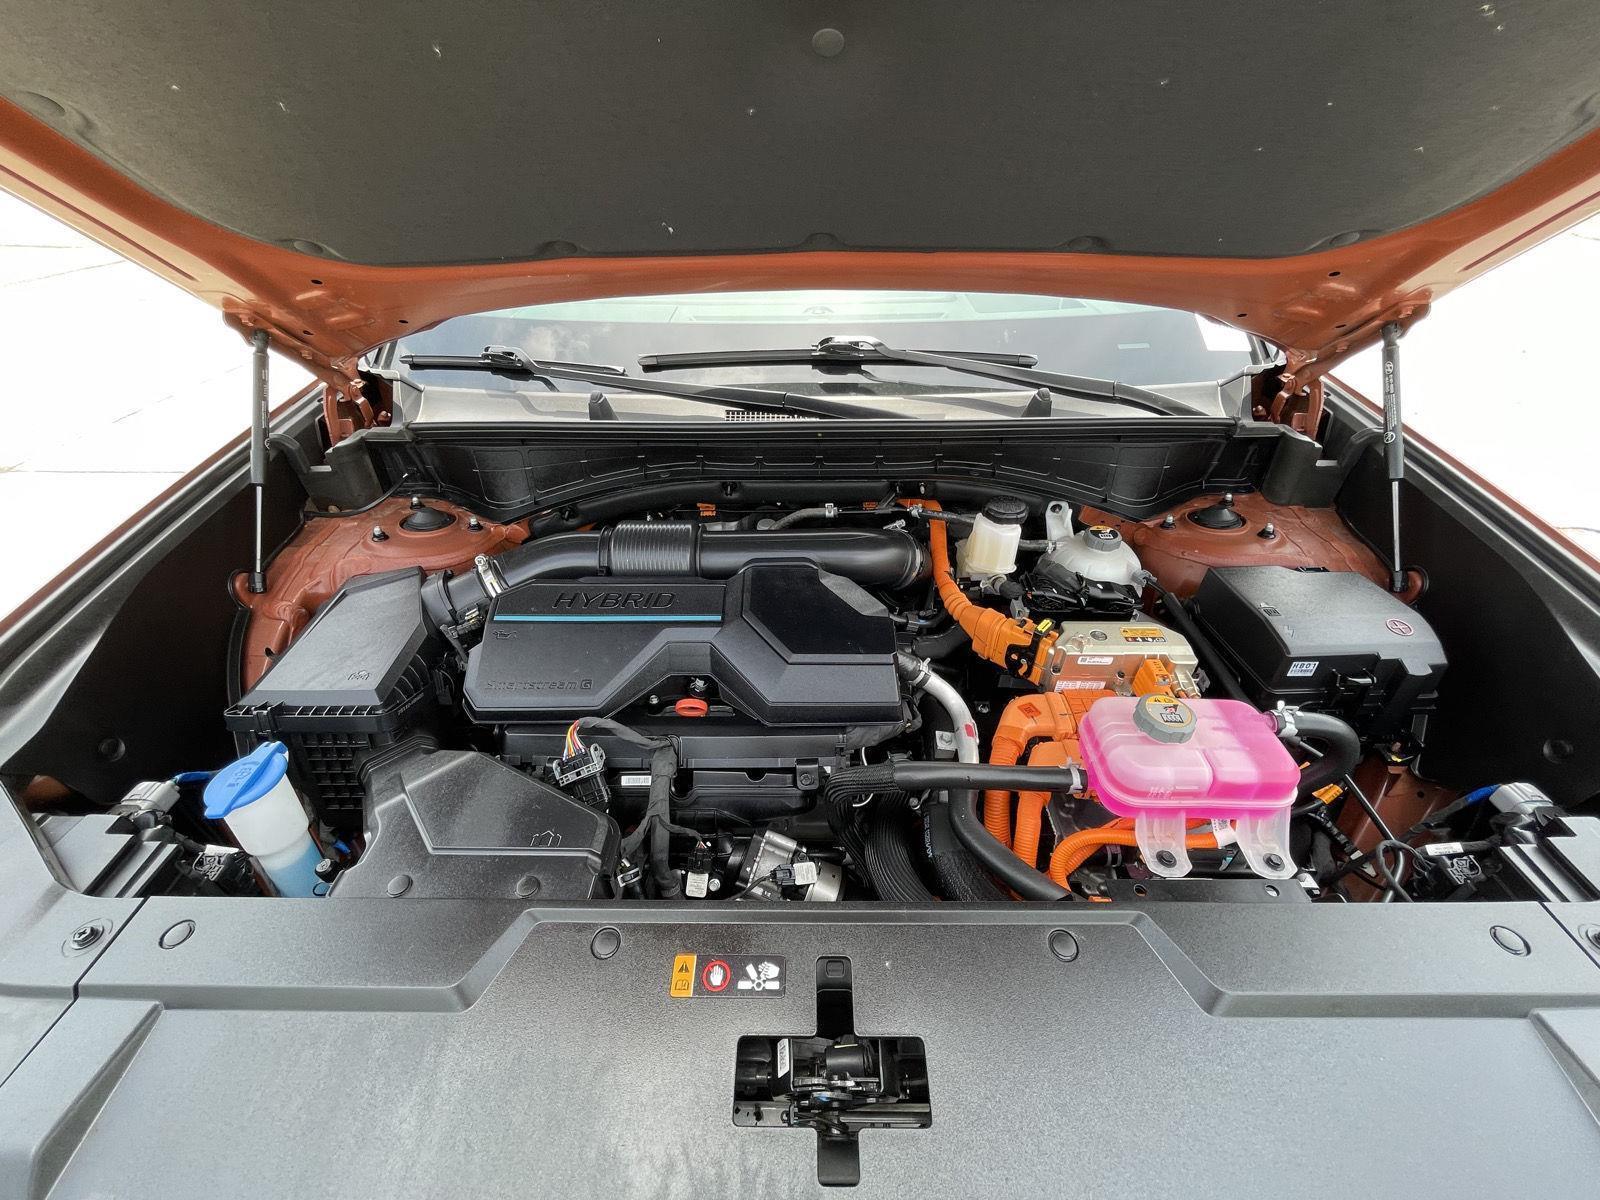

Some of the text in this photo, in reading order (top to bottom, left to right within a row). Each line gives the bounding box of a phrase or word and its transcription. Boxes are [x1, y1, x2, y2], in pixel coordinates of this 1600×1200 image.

[551, 592, 676, 609] HYBRID
[485, 679, 593, 691] Smartstream G
